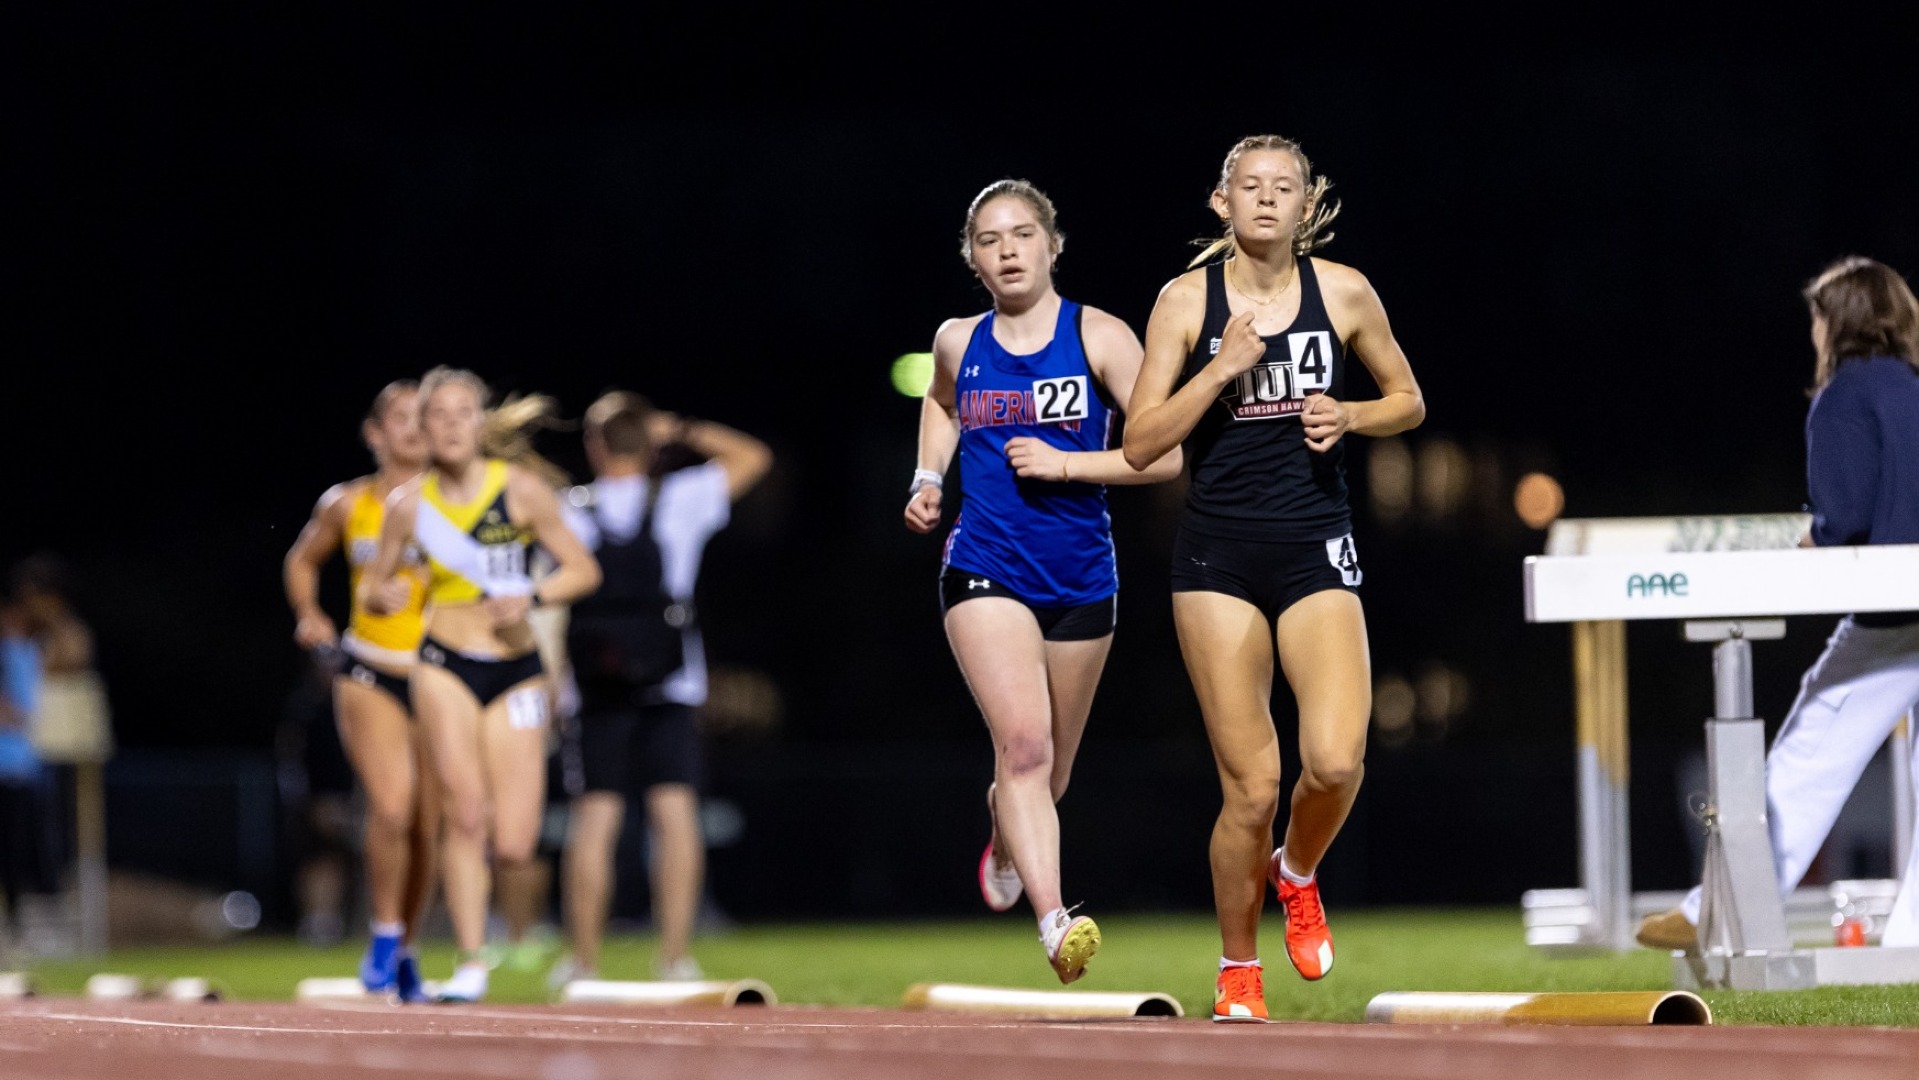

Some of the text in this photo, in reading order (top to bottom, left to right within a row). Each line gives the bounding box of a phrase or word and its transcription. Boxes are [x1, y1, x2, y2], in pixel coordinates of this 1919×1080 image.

[1299, 336, 1327, 384] 4
[1038, 379, 1082, 420] 22
[1237, 400, 1305, 416] CRIMSON HAW
[1338, 536, 1359, 582] 4
